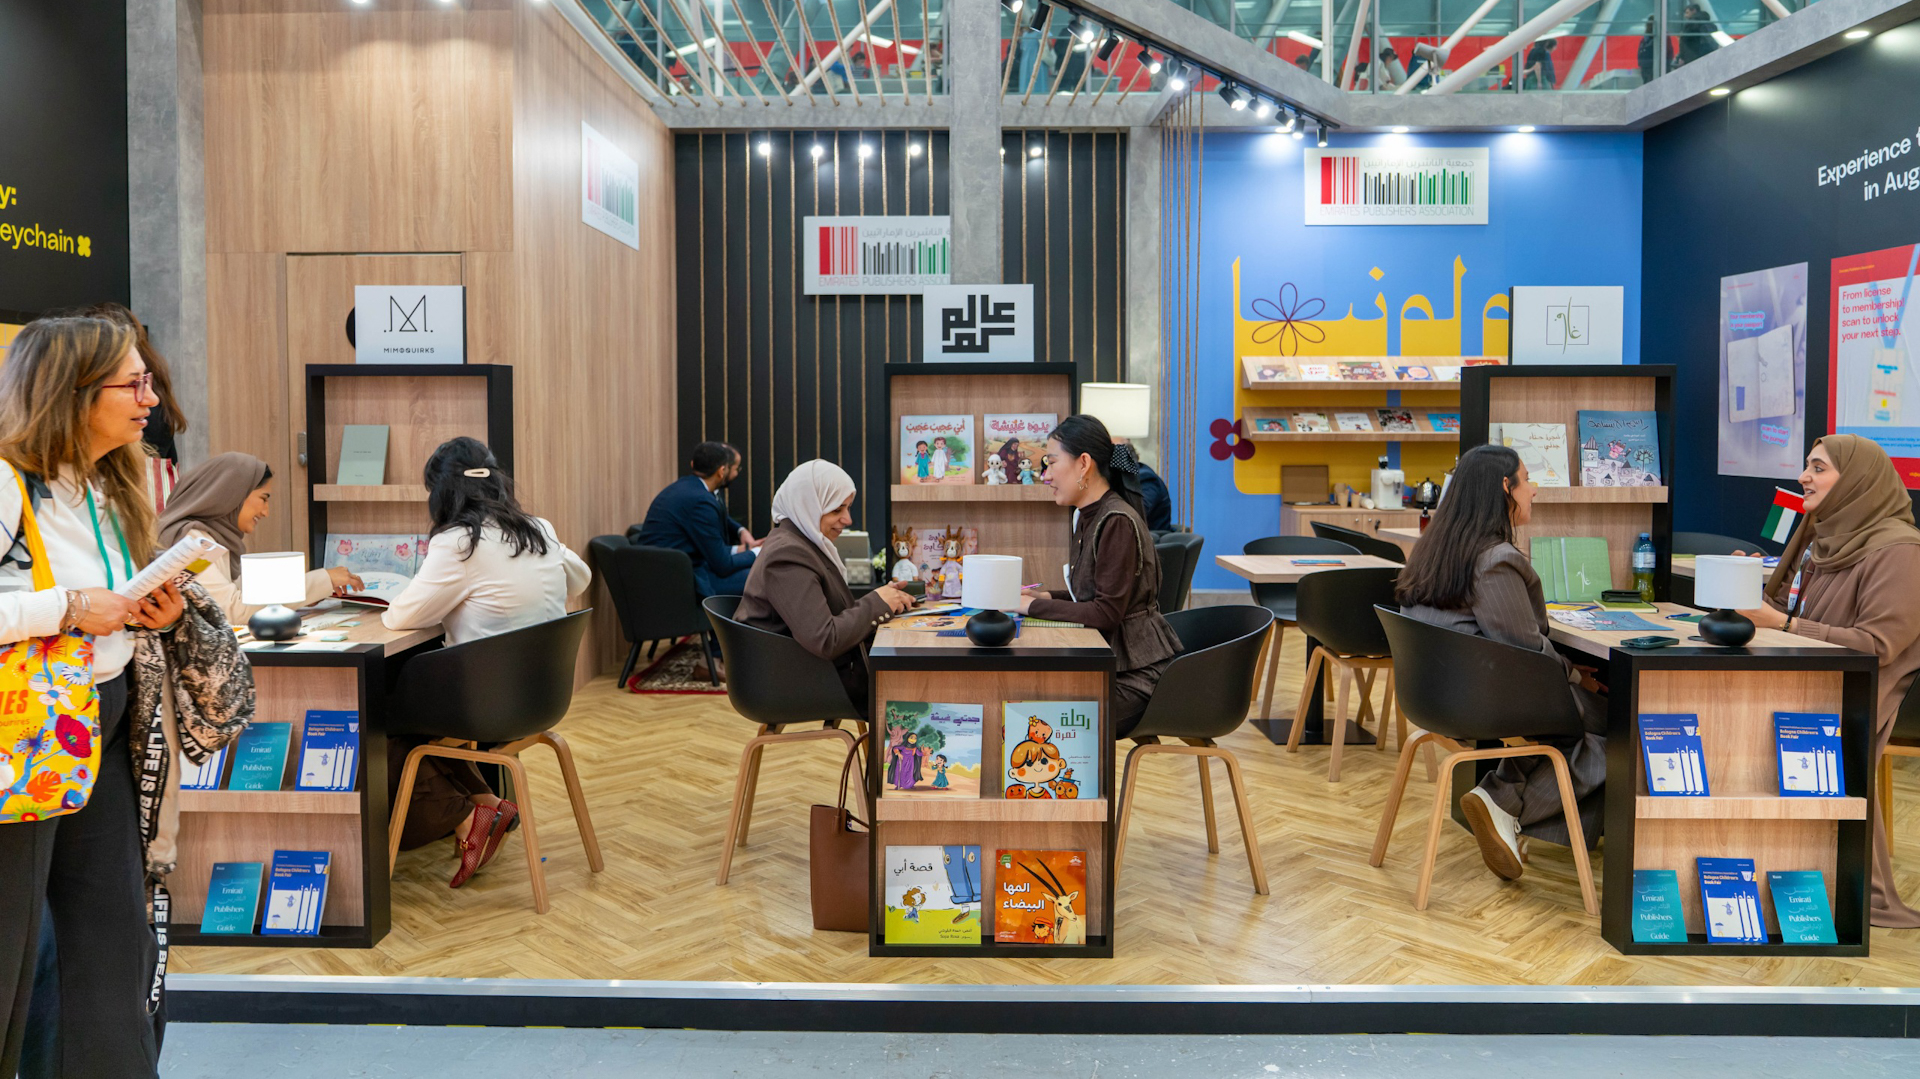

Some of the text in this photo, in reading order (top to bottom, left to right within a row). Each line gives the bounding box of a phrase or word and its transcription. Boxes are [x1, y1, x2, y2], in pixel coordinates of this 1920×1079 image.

[1818, 138, 1911, 186] Experience
[1864, 166, 1920, 201] in Aug
[1320, 206, 1474, 216] EMIRATES PUBLISHERS ASSOCIATION
[0, 223, 75, 254] eychain
[818, 276, 860, 286] EMIRATES
[862, 276, 917, 286] PUBLISHERS
[1843, 287, 1891, 300] From license
[1843, 297, 1905, 313] to membership!
[1842, 312, 1899, 327] scan to unlock
[1842, 327, 1901, 343] your next step.
[1061, 708, 1090, 730] رحلة
[144, 732, 163, 772] LIFE
[140, 774, 158, 793] IS
[910, 862, 933, 872] قصة
[1003, 882, 1030, 895] المها
[1003, 898, 1045, 912] البيضاء
[1640, 913, 1672, 921] Publishers
[151, 884, 169, 1002] LIFE IS BEAU
[1650, 932, 1669, 940] Guide
